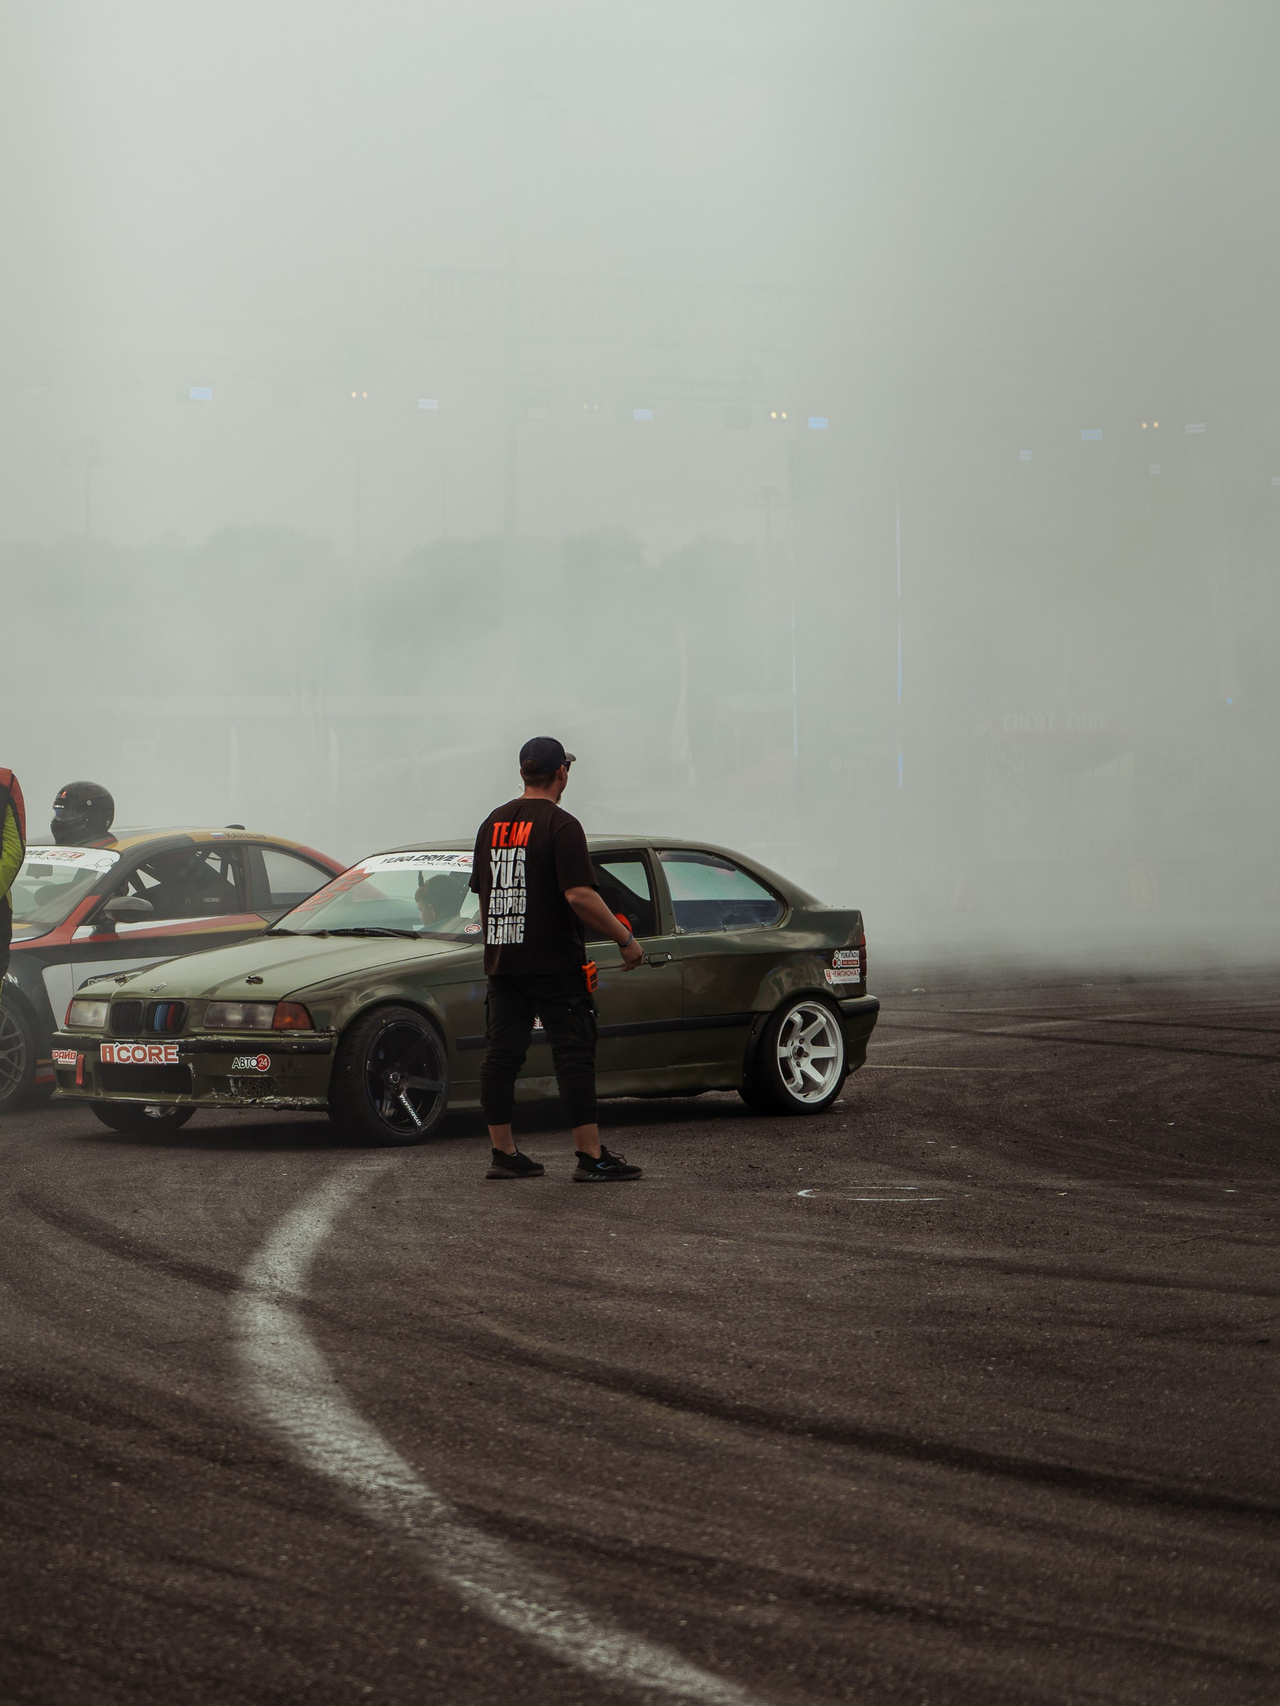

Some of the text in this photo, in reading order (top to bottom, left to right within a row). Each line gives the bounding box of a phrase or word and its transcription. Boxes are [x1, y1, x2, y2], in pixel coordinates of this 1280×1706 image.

[491, 821, 532, 847] TEAM
[52, 1049, 77, 1061] РАЙВ
[399, 1094, 423, 1126] GYMKHANA
